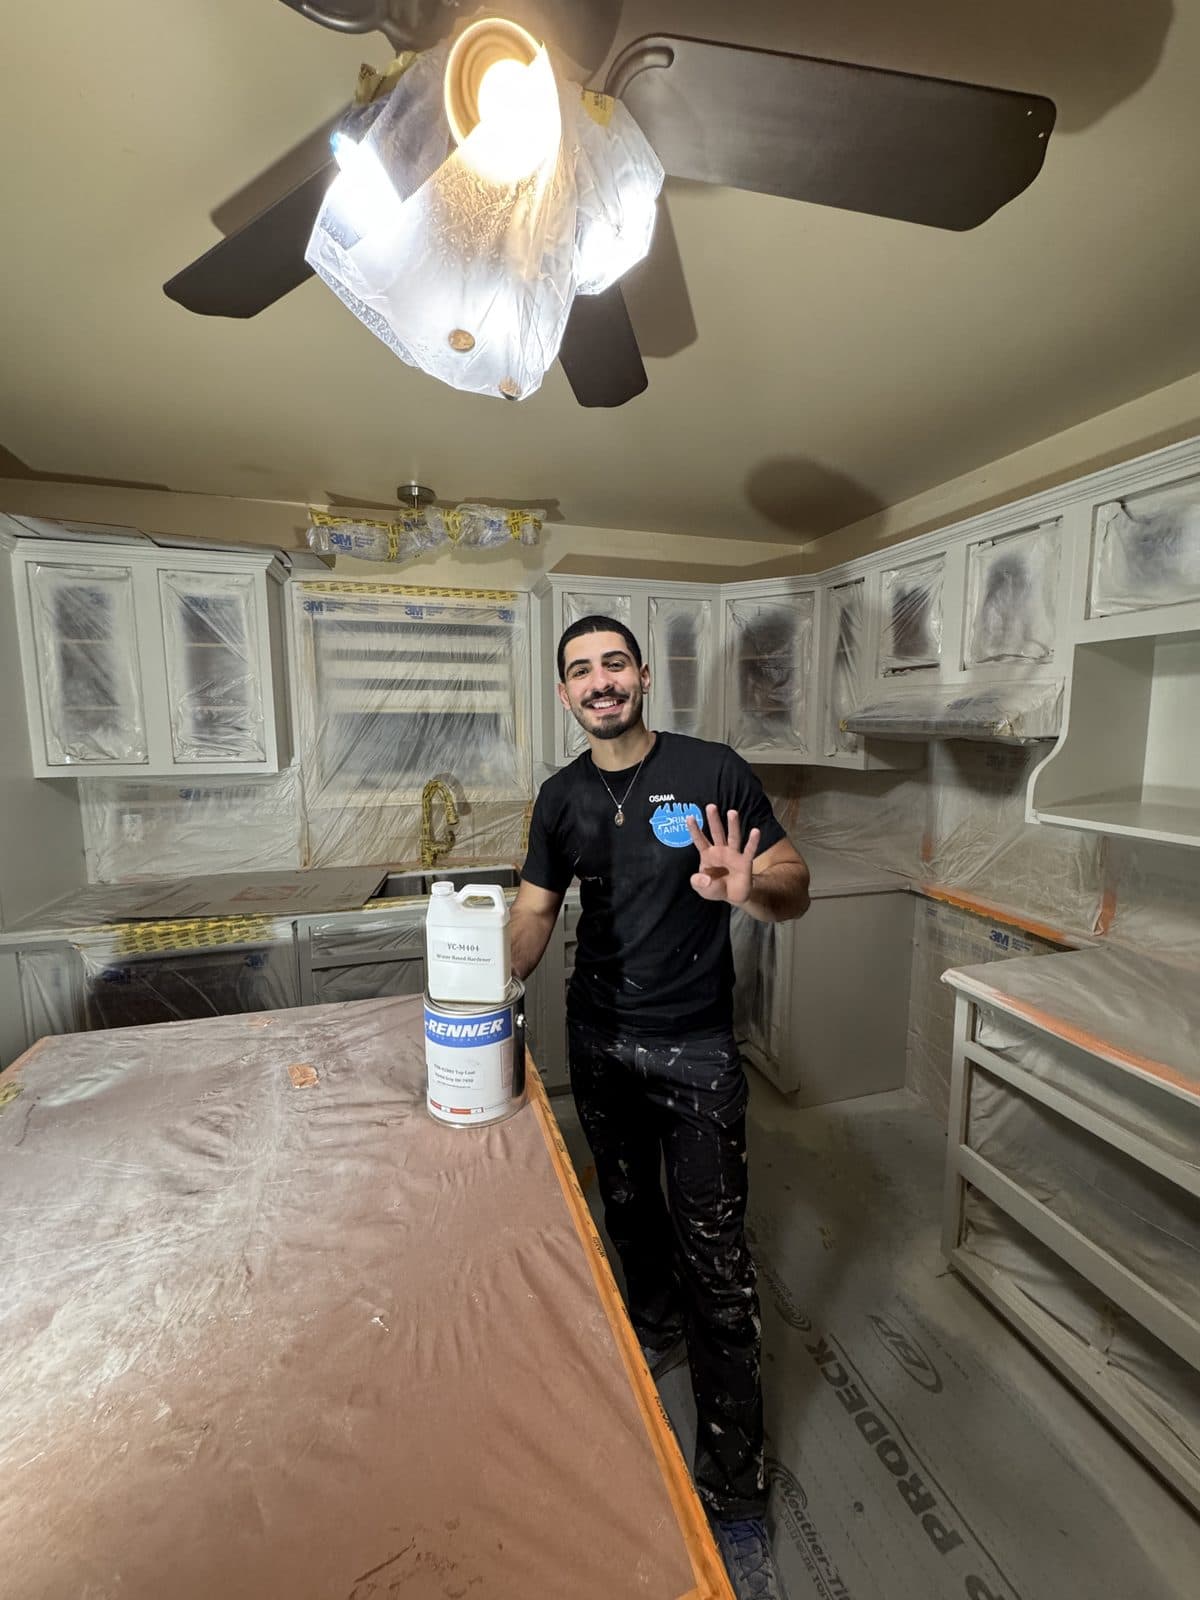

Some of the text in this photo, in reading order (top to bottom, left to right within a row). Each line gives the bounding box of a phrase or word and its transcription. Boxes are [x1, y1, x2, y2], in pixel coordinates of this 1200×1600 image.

[330, 533, 352, 546] 3M
[303, 601, 324, 612] 3M
[405, 606, 424, 616] 3M
[649, 793, 675, 802] OSAMA
[989, 929, 1010, 946] 3M
[428, 1018, 504, 1038] RENNER
[804, 1337, 965, 1555] PRODECK
